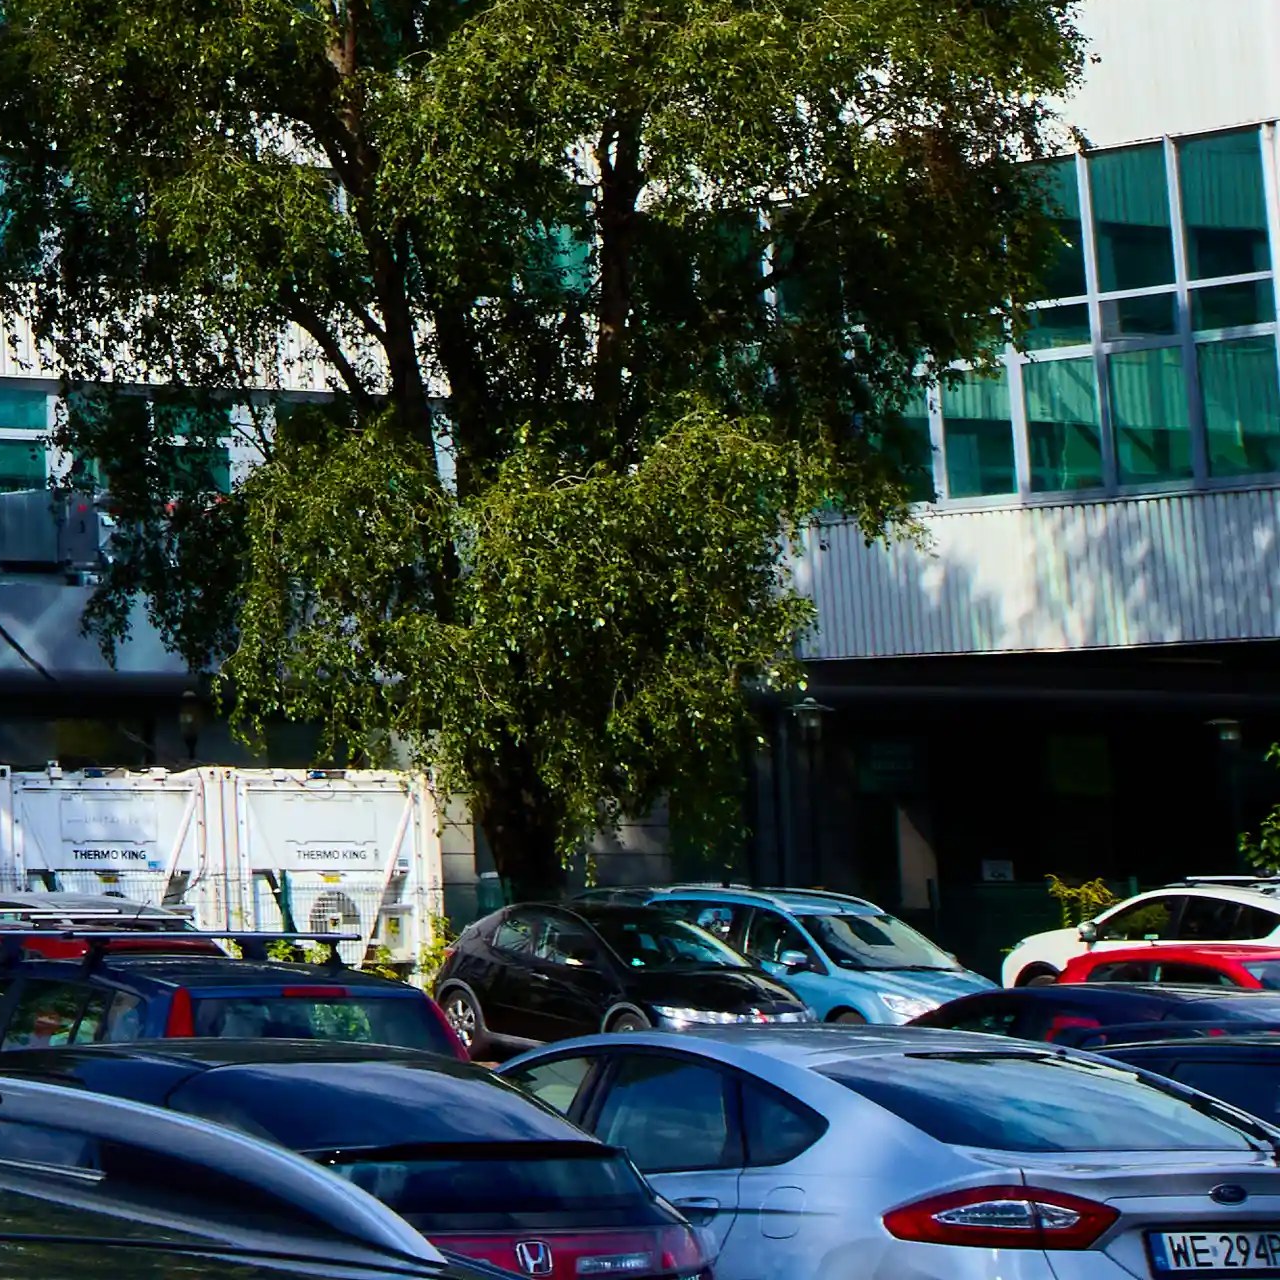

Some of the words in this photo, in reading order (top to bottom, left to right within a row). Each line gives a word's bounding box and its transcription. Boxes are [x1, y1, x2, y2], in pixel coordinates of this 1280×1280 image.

[73, 849, 119, 860] THERMO
[121, 849, 147, 860] KING
[296, 849, 340, 860] THERMO
[342, 849, 367, 860] KING
[1168, 1235, 1214, 1268] WE
